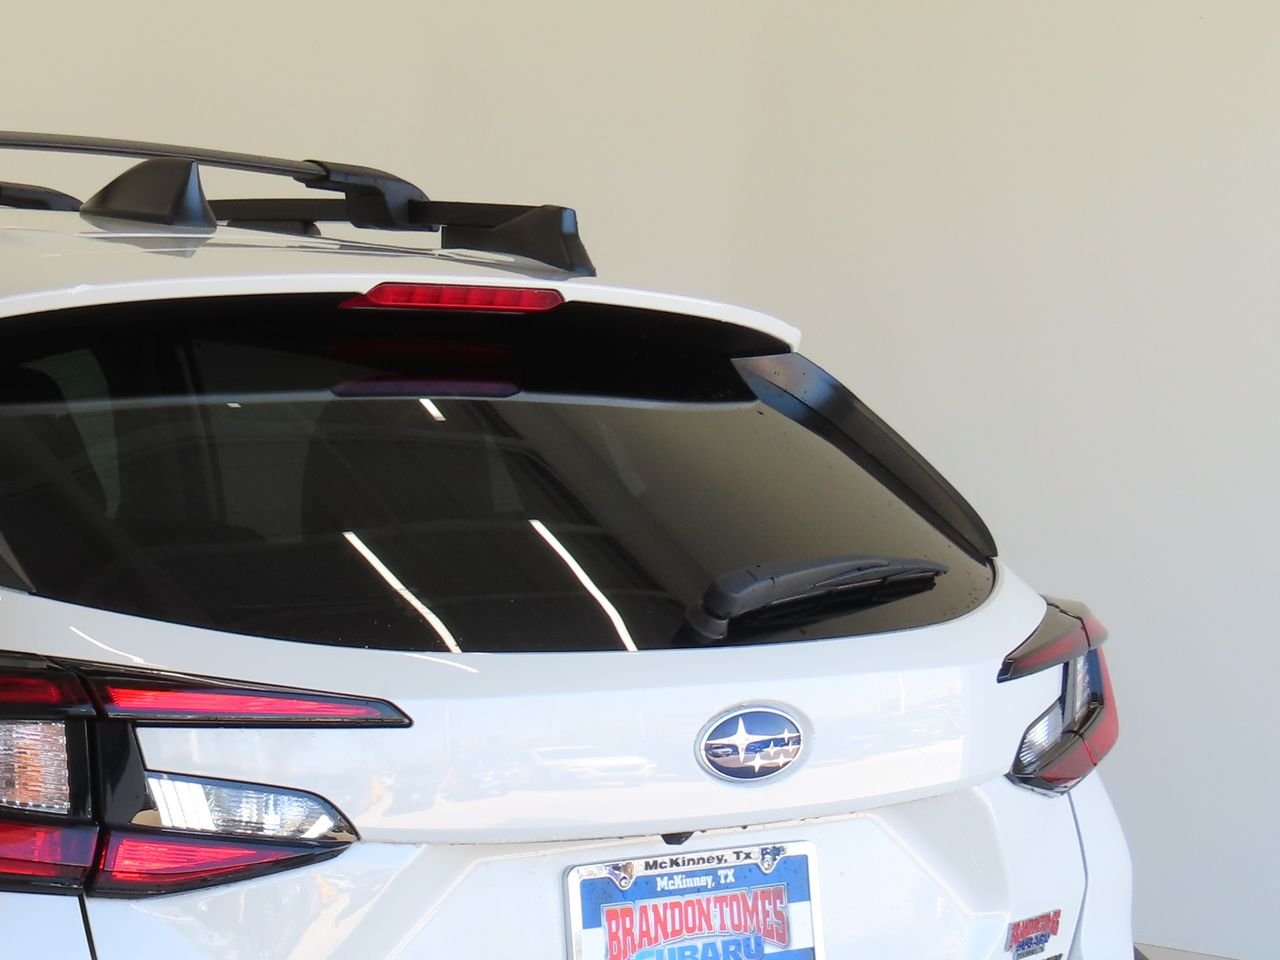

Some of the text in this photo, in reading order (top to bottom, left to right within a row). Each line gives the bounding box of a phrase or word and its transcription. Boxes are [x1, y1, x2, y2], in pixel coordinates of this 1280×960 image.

[644, 850, 752, 871] McKinney, Tx
[656, 868, 735, 891] McKinney, TX
[713, 886, 791, 949] TOMES
